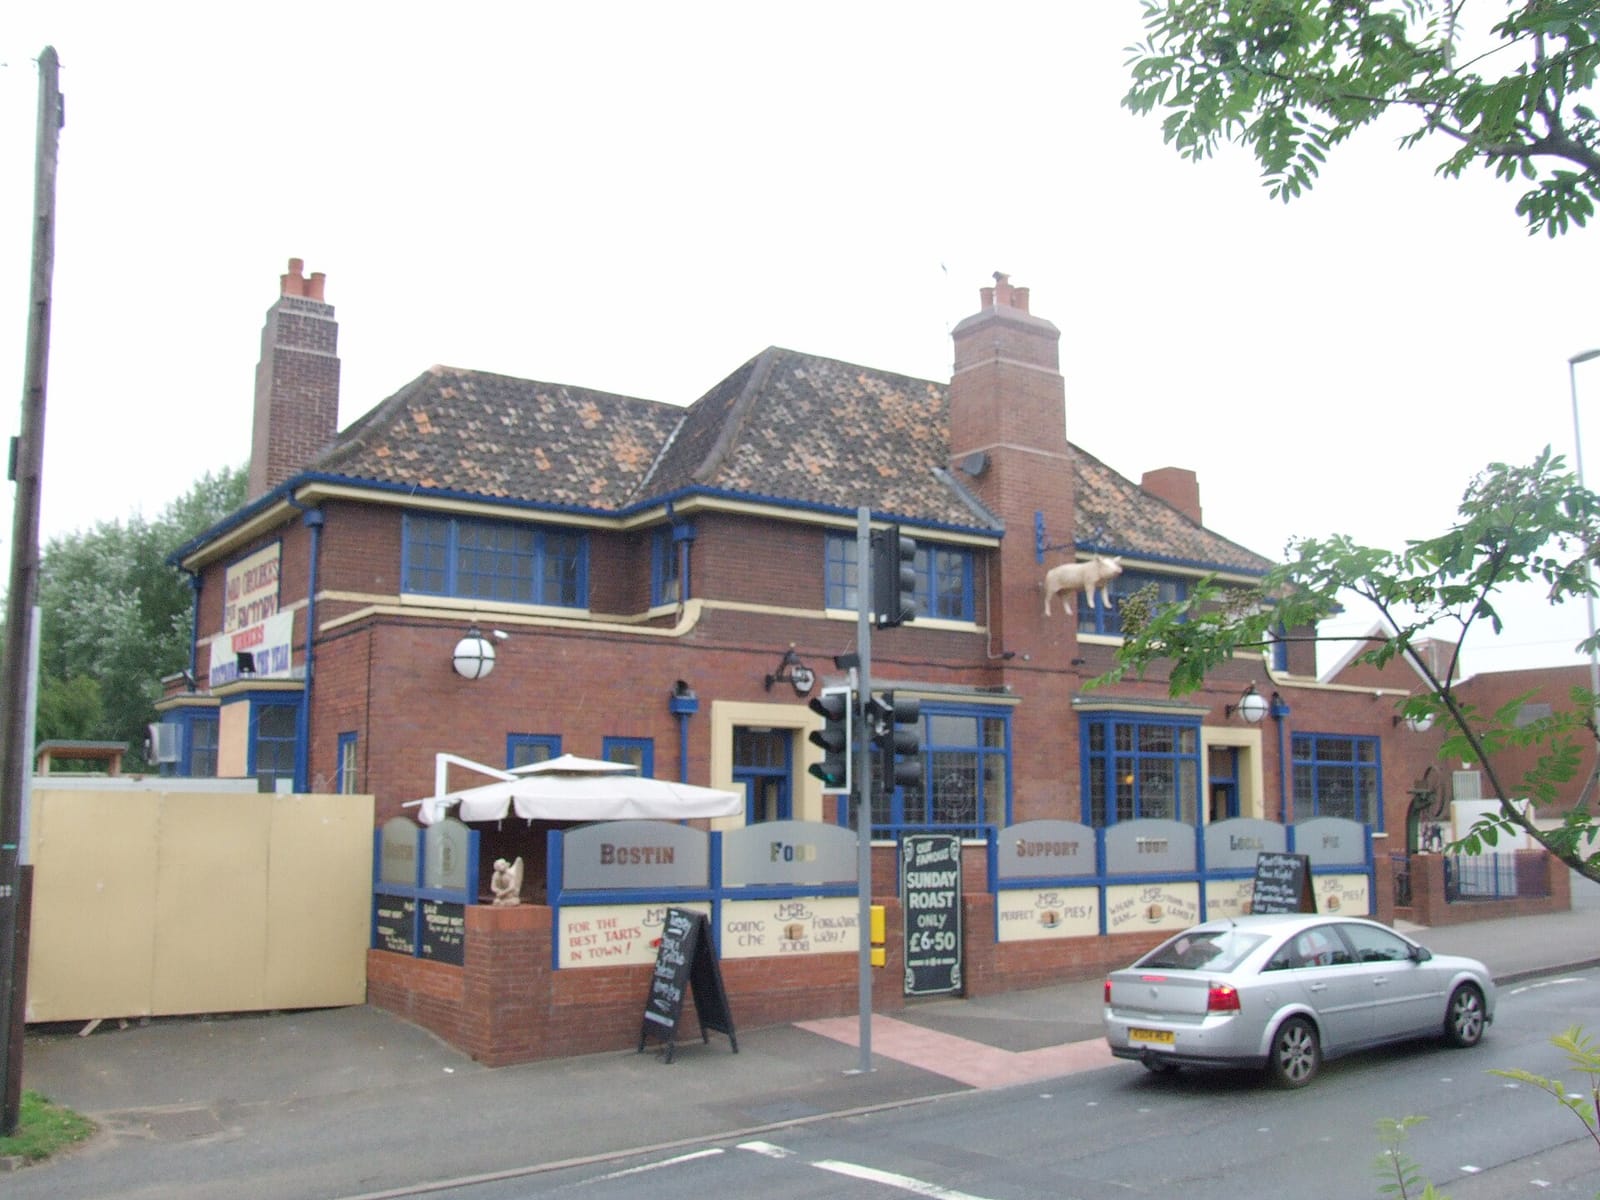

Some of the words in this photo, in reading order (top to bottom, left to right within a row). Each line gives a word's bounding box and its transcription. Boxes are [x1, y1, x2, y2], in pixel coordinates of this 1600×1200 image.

[600, 843, 675, 865] BOSTIN
[770, 842, 816, 862] FOOD
[1016, 838, 1079, 857] SUPPORT
[916, 848, 950, 866] FAMOUS
[907, 871, 957, 889] SUNDAY
[909, 891, 955, 909] ROAST
[568, 921, 591, 934] FOR
[596, 918, 618, 929] THE
[727, 920, 765, 933] GOING
[917, 914, 947, 929] ONLY
[569, 935, 597, 947] BEST
[605, 927, 641, 942] TARTS
[570, 951, 582, 961] IN
